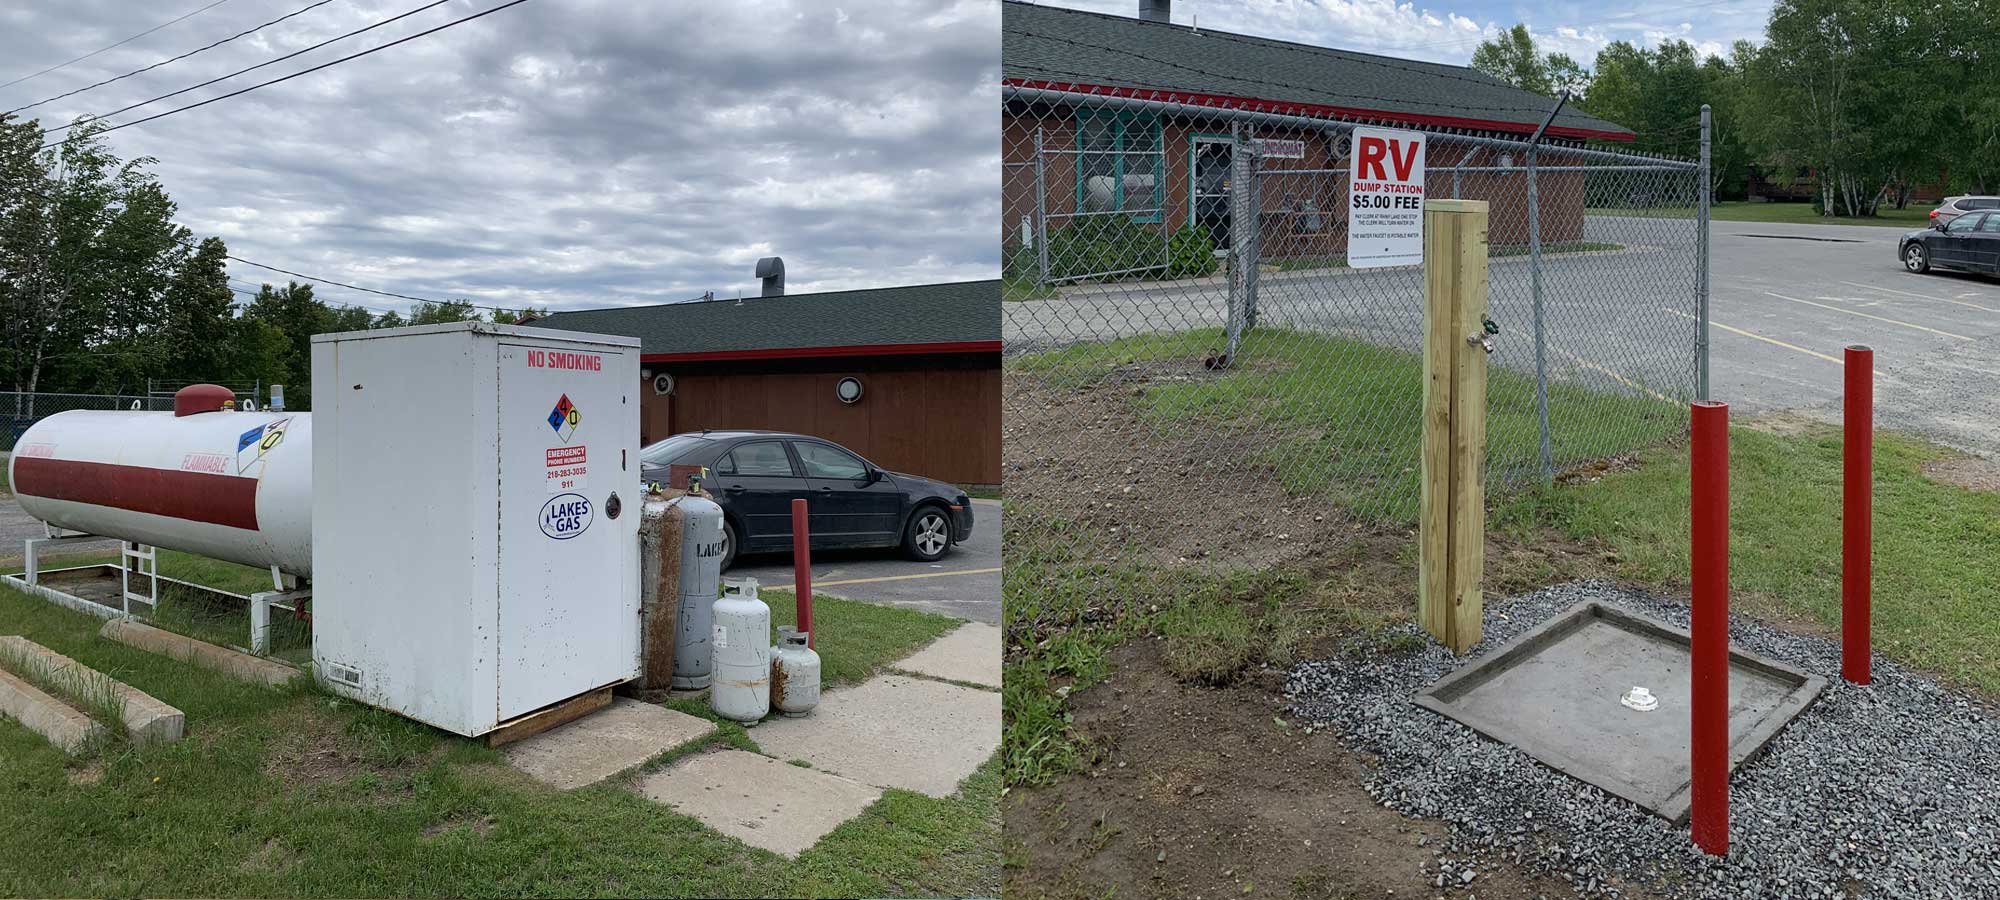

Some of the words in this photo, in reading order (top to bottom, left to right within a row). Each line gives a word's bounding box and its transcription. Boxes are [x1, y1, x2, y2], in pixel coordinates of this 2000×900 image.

[1357, 136, 1420, 181] RV
[1354, 182, 1381, 192] DUMP
[1384, 184, 1422, 194] STATION
[1353, 194, 1390, 210] $5.00
[1395, 196, 1420, 209] FEE
[528, 351, 544, 367] NO
[548, 353, 601, 371] SMOKING
[560, 398, 567, 413] 4
[553, 410, 560, 427] 2
[569, 410, 578, 425] 0
[261, 430, 282, 450] 0
[547, 458, 563, 466] PHONE
[564, 456, 585, 464] NUMBERS
[548, 448, 585, 458] EMERGENCY
[180, 455, 230, 473] FLAMMABLE
[547, 466, 587, 479] 218-283-3035
[561, 480, 573, 488] 911
[552, 500, 588, 518] LAKES
[556, 516, 580, 532] GAS
